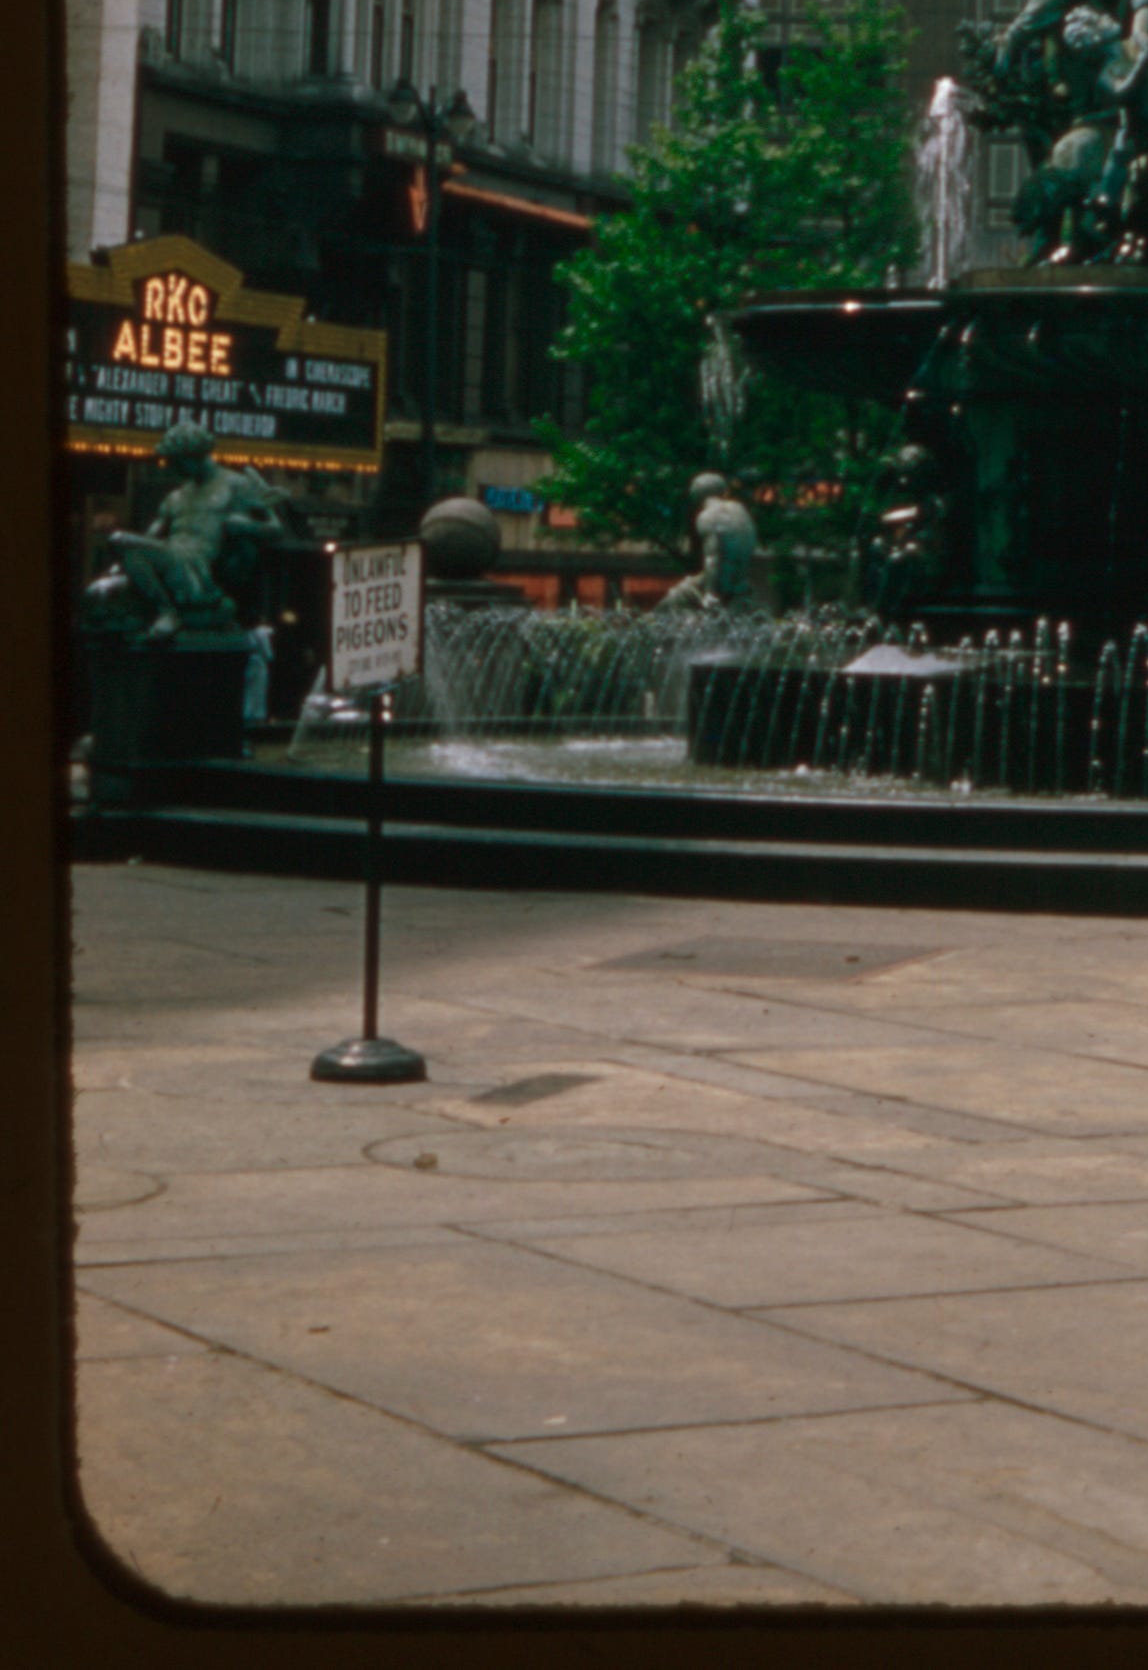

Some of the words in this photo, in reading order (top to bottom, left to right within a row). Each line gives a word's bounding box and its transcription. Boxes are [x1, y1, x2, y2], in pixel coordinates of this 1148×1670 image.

[145, 274, 208, 326] RKO
[111, 320, 232, 375] ALBEE
[343, 589, 362, 619] TO
[366, 582, 402, 617] FEED
[336, 612, 408, 653] PIGEONS
